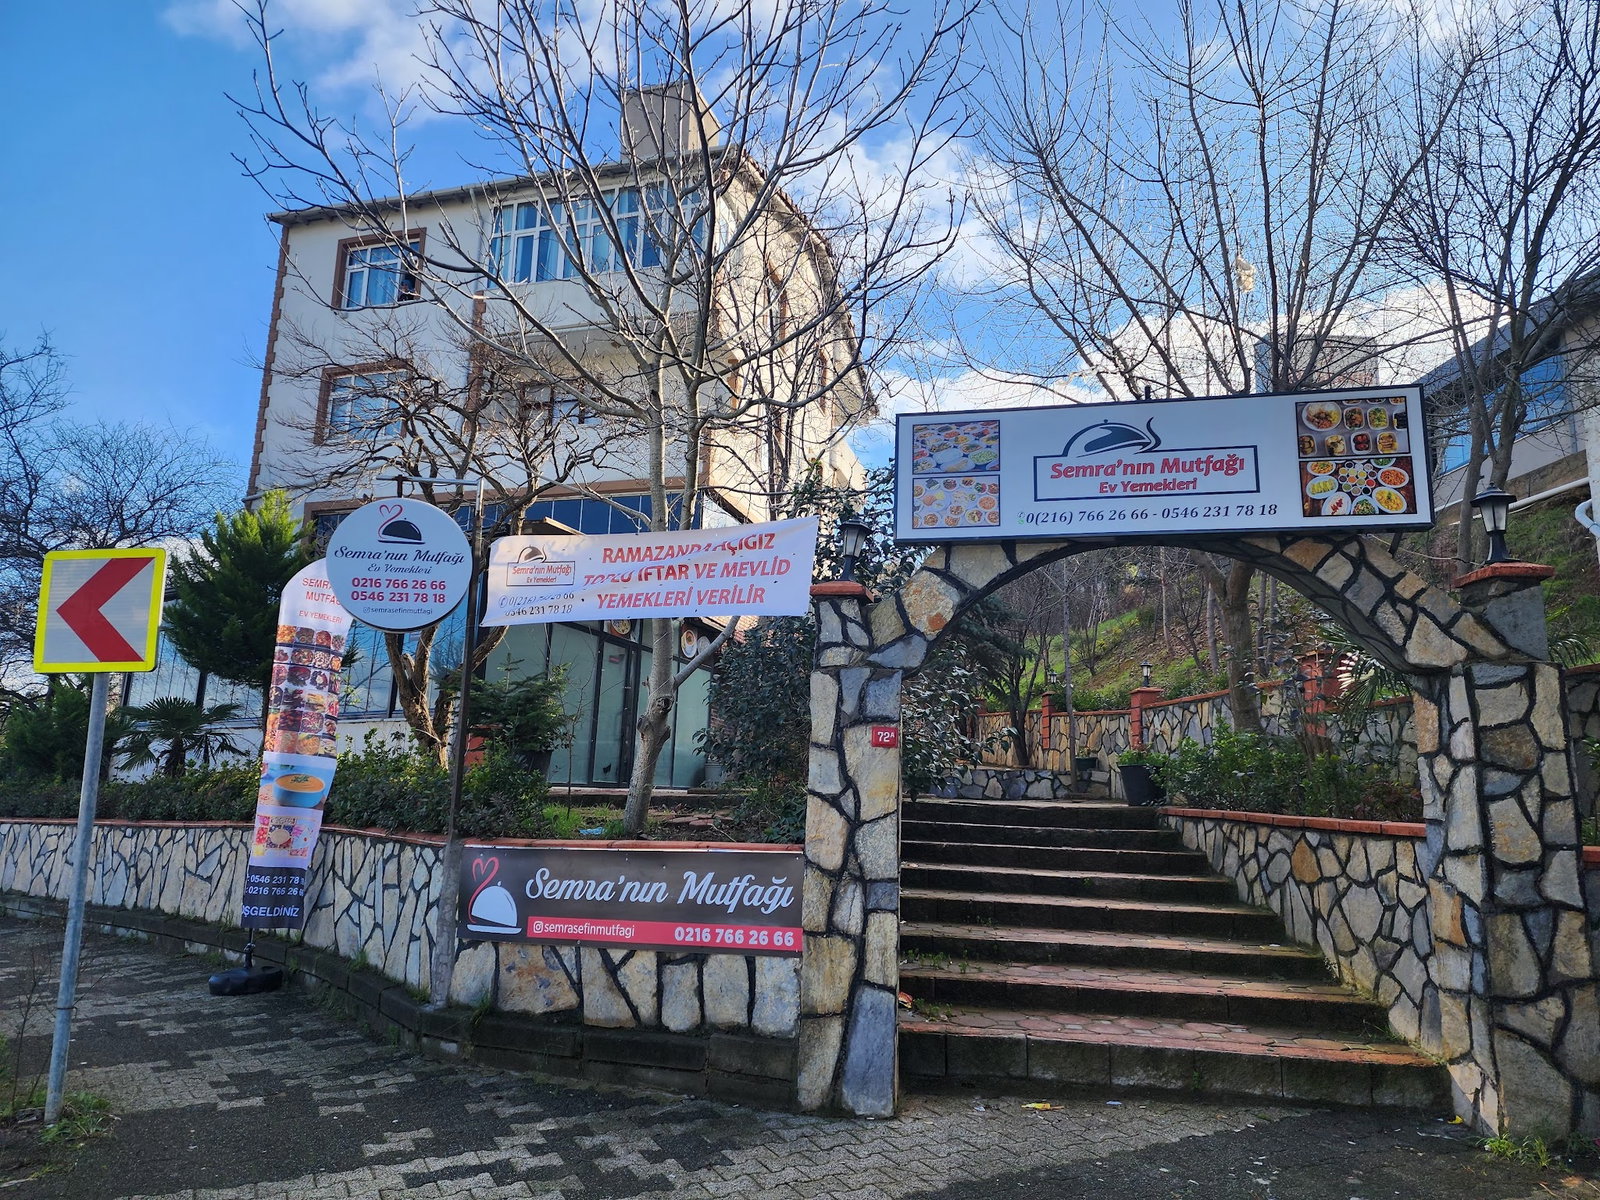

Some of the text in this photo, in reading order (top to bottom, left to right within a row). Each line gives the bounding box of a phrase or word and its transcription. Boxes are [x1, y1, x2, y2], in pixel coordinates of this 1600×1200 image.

[1160, 453, 1245, 476] Mutfağı
[1099, 477, 1198, 493] Ev Yemekleri
[1026, 511, 1073, 525] 0(216)
[1078, 510, 1104, 522] 766
[1108, 509, 1126, 521] 26
[1130, 508, 1149, 520] 66
[1161, 506, 1199, 519] 0546
[1203, 505, 1230, 518] 231
[1236, 504, 1254, 516] 78
[1259, 504, 1278, 516] 18
[413, 549, 465, 566] Mutfağı
[367, 563, 432, 575] Ev Yemekleri
[694, 562, 718, 579] VE
[720, 555, 791, 578] MEVLİD
[302, 577, 332, 590] SEMR
[351, 577, 446, 591] 0216 766 26 66
[351, 590, 446, 603] 0546 231 78 18
[597, 584, 766, 609] YEMEKLERİ VERİLİR
[529, 605, 545, 615] 231
[548, 604, 560, 614] 78
[561, 604, 573, 614] 18
[272, 876, 287, 884] 231
[289, 876, 300, 884] 78
[676, 870, 796, 916] Mutfağı
[543, 921, 795, 947] semrasefinmutfagi 0216 766 26 66
